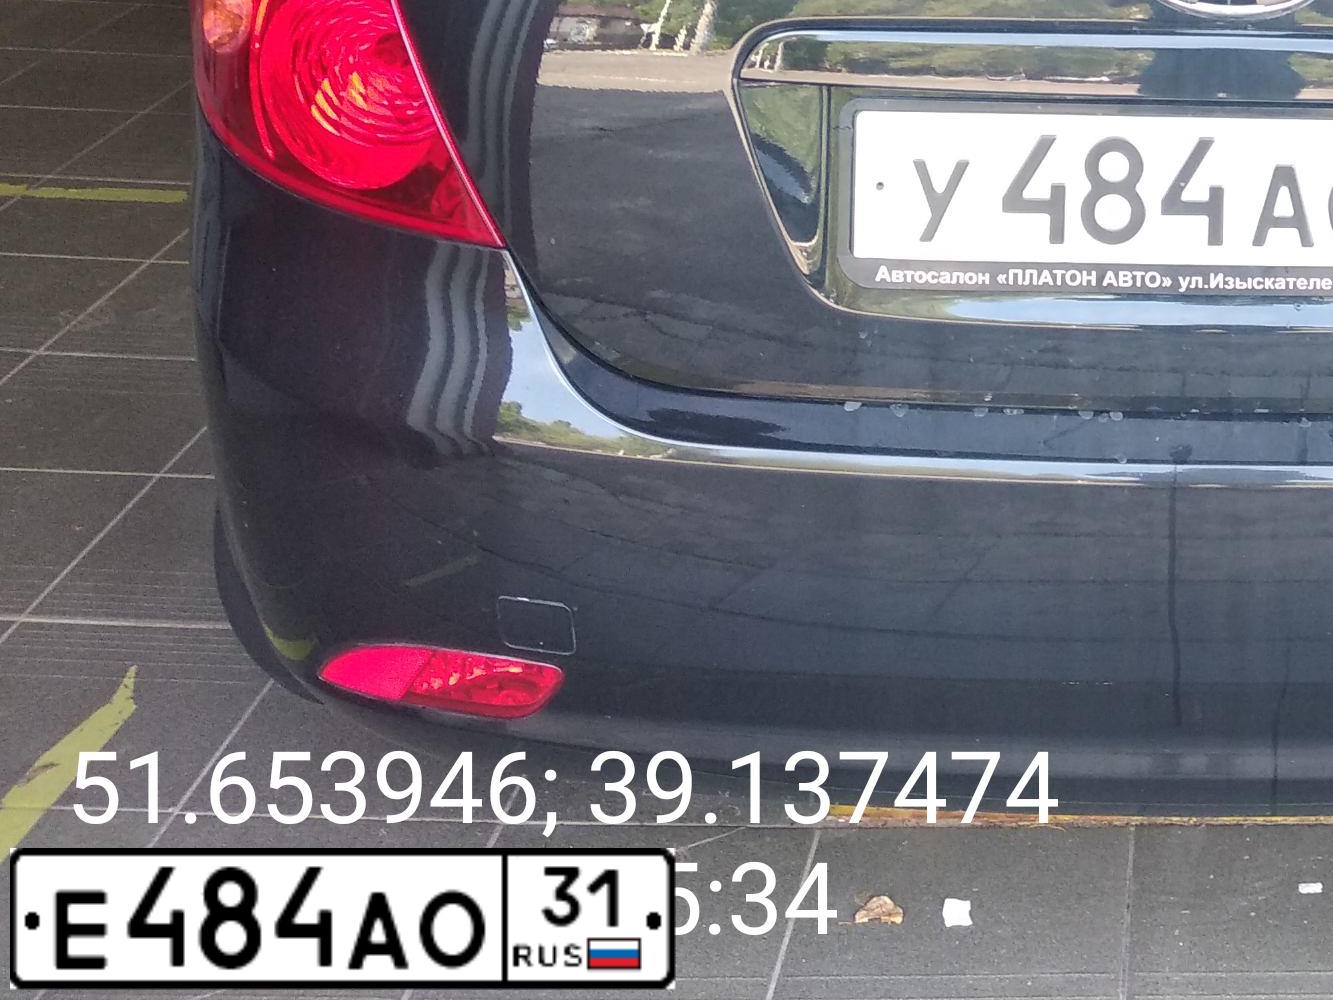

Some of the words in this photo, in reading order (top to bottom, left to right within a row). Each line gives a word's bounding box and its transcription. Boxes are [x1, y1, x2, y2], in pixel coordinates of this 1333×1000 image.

[875, 265, 990, 285] Автосалон
[997, 268, 1097, 288] «ПЛАТОН
[1102, 269, 1172, 289] АВТО»
